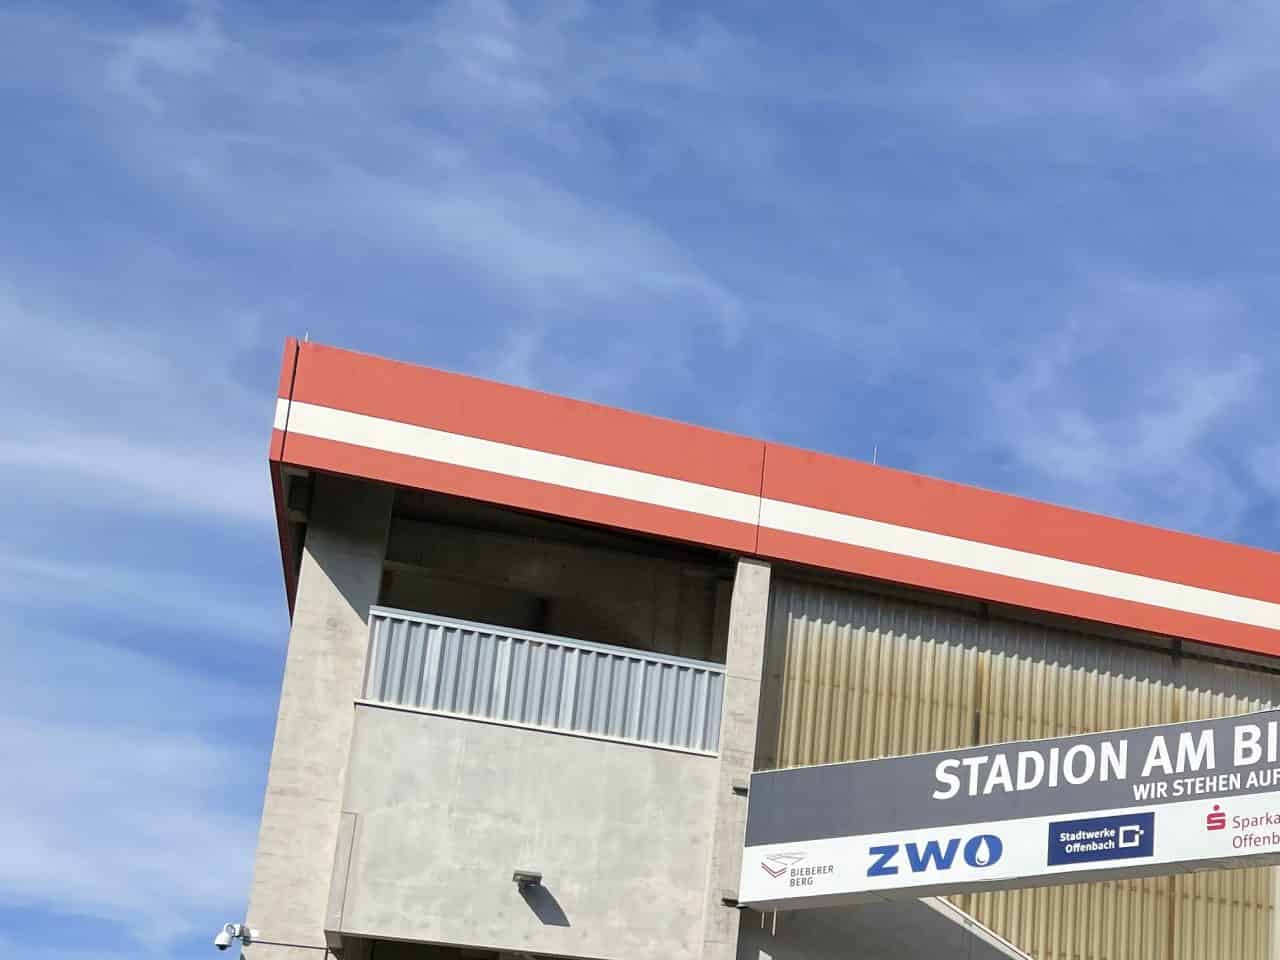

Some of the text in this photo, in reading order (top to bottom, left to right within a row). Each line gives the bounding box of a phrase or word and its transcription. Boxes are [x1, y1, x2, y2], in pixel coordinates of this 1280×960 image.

[932, 739, 1128, 800] STADION
[1141, 729, 1216, 777] AM
[1133, 781, 1168, 801] WIR
[1172, 773, 1241, 797] STEHEN
[1059, 828, 1116, 843] Stadtwerke
[1065, 839, 1116, 854] Offenbach
[867, 834, 1002, 877] ZWO
[790, 864, 834, 877] BIEBERER
[789, 876, 814, 888] BERG
